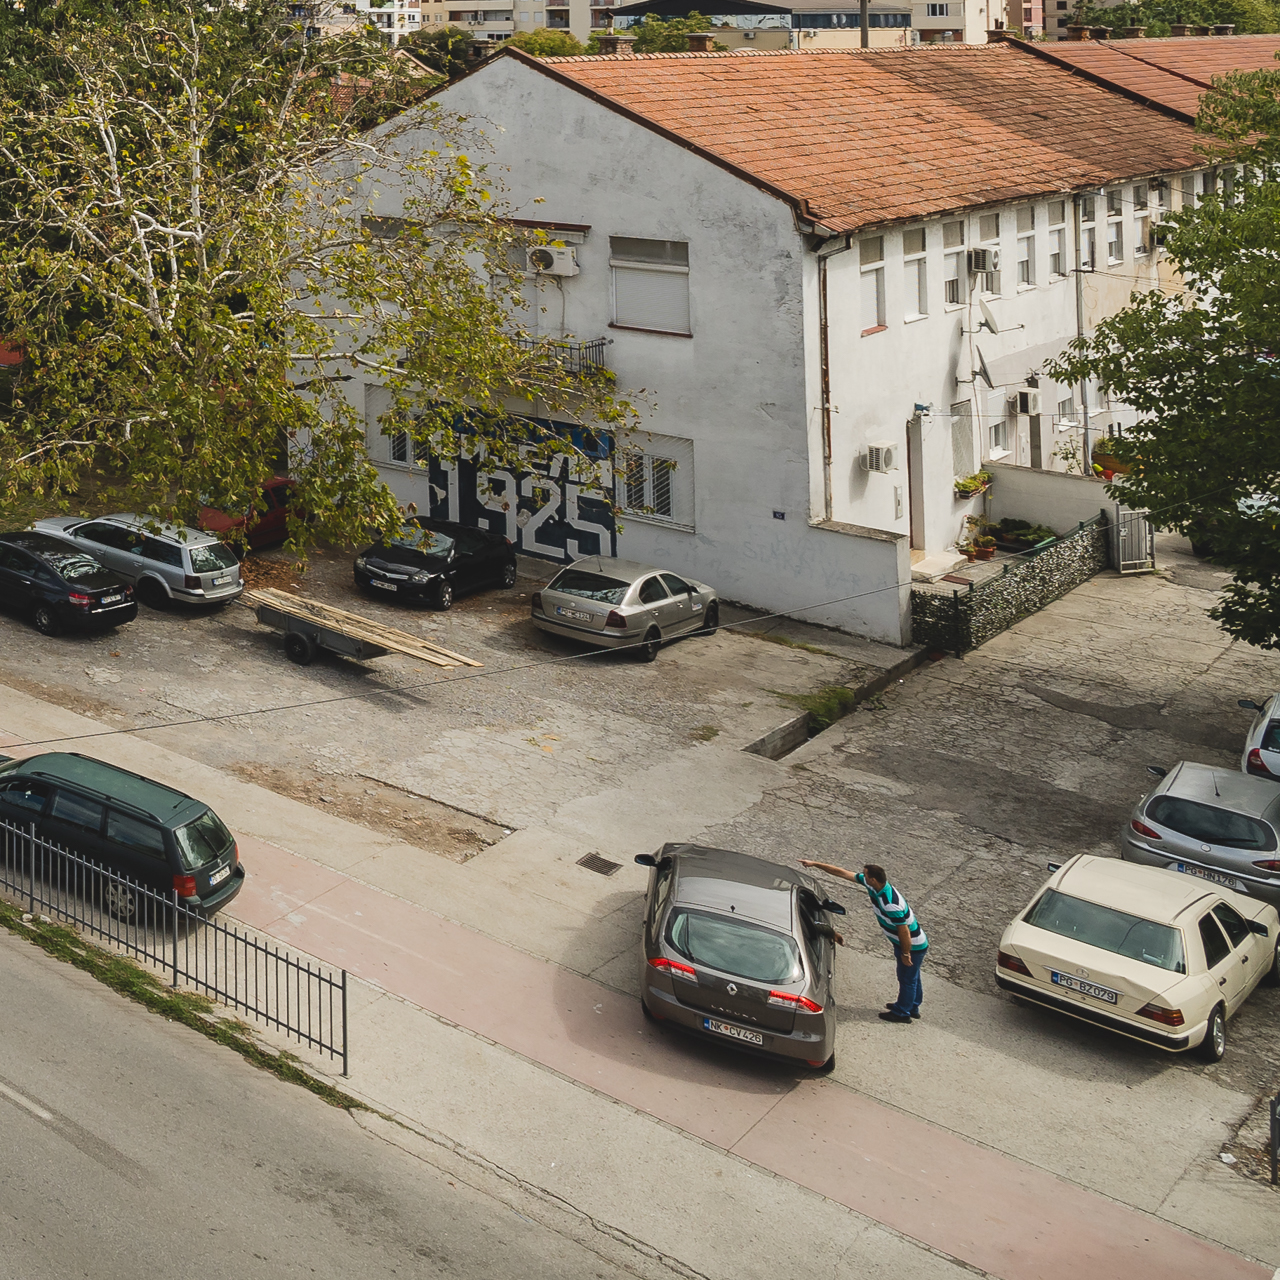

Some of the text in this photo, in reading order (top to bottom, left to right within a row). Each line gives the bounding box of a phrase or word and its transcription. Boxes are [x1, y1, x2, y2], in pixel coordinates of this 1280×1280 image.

[440, 460, 612, 561] 1925
[1184, 865, 1198, 875] PG
[1059, 975, 1073, 987] PG
[710, 1020, 723, 1032] NK
